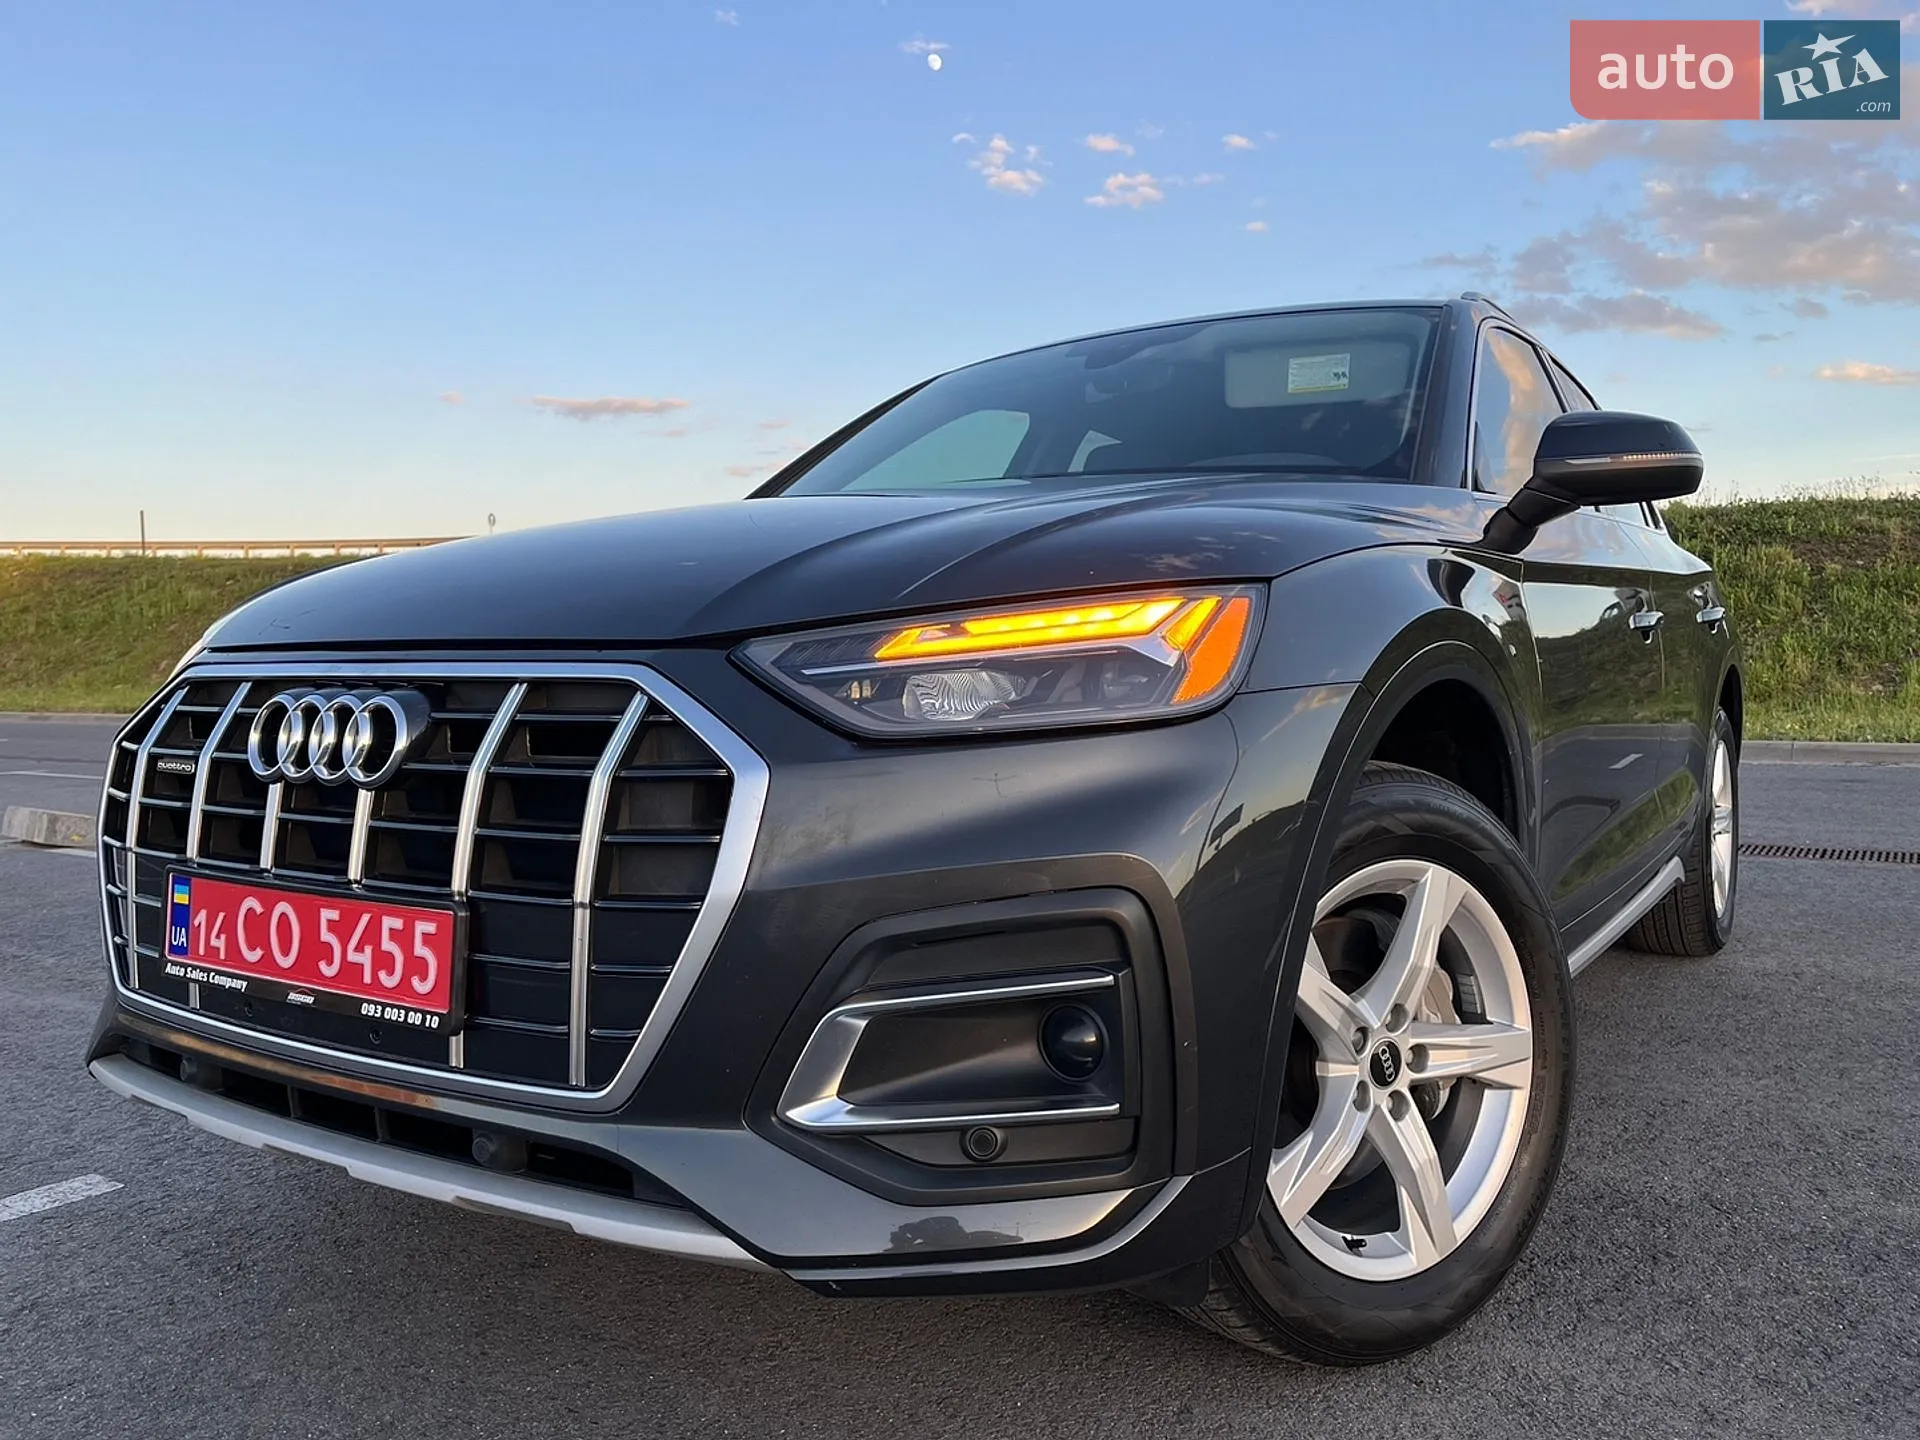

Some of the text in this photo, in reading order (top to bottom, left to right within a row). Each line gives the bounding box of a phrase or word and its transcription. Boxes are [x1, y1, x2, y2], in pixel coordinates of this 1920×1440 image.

[157, 762, 192, 772] quattro
[171, 926, 187, 948] UA
[317, 908, 438, 995] 5455
[165, 962, 248, 992] Auto Sales Company
[361, 1002, 440, 1029] 093 003 00 10
